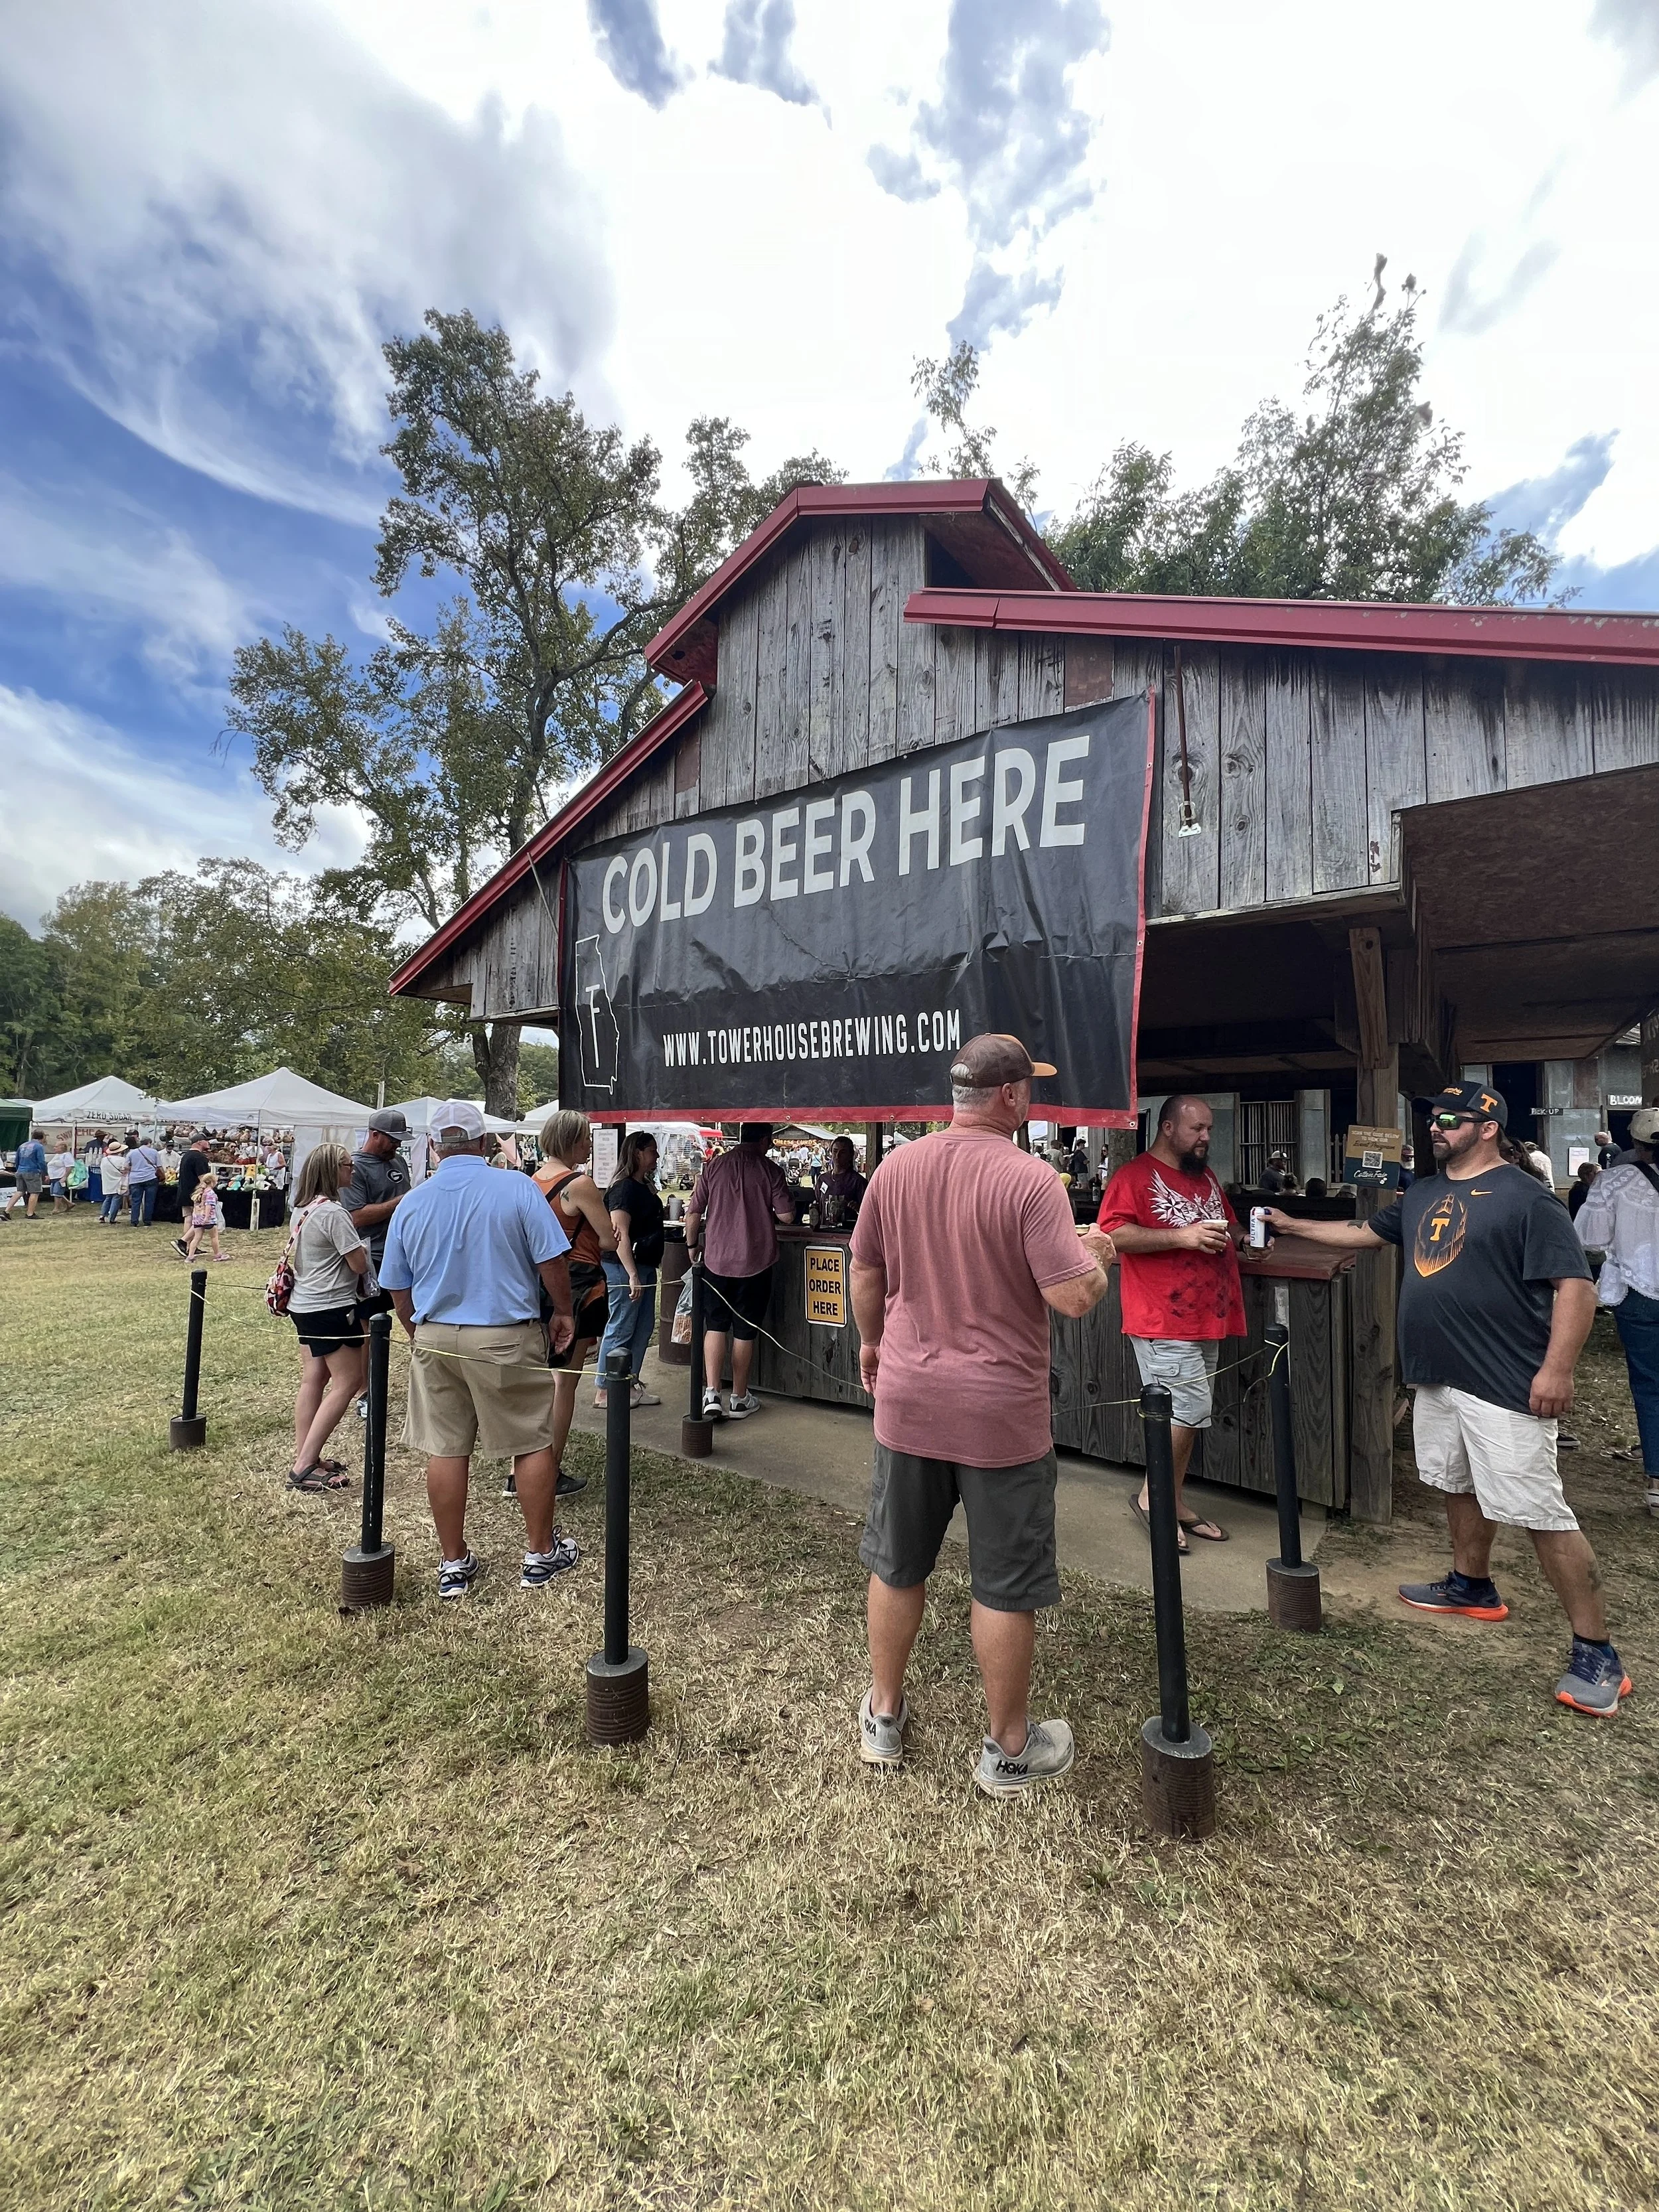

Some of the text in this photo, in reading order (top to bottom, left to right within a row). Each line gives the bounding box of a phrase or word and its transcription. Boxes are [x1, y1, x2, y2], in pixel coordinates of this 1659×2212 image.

[603, 735, 1090, 934] COLD BEER HERE
[662, 1009, 960, 1067] WWW.TOWERHOUSEBREWING.COM
[1480, 1093, 1498, 1113] T
[86, 1110, 107, 1120] ZERO
[108, 1112, 133, 1122] SUGAR
[1430, 1218, 1450, 1241] T
[810, 1258, 839, 1272] PLACE
[809, 1279, 841, 1294] ORDER
[813, 1301, 838, 1316] HERE
[995, 1759, 1028, 1775] HOKA
